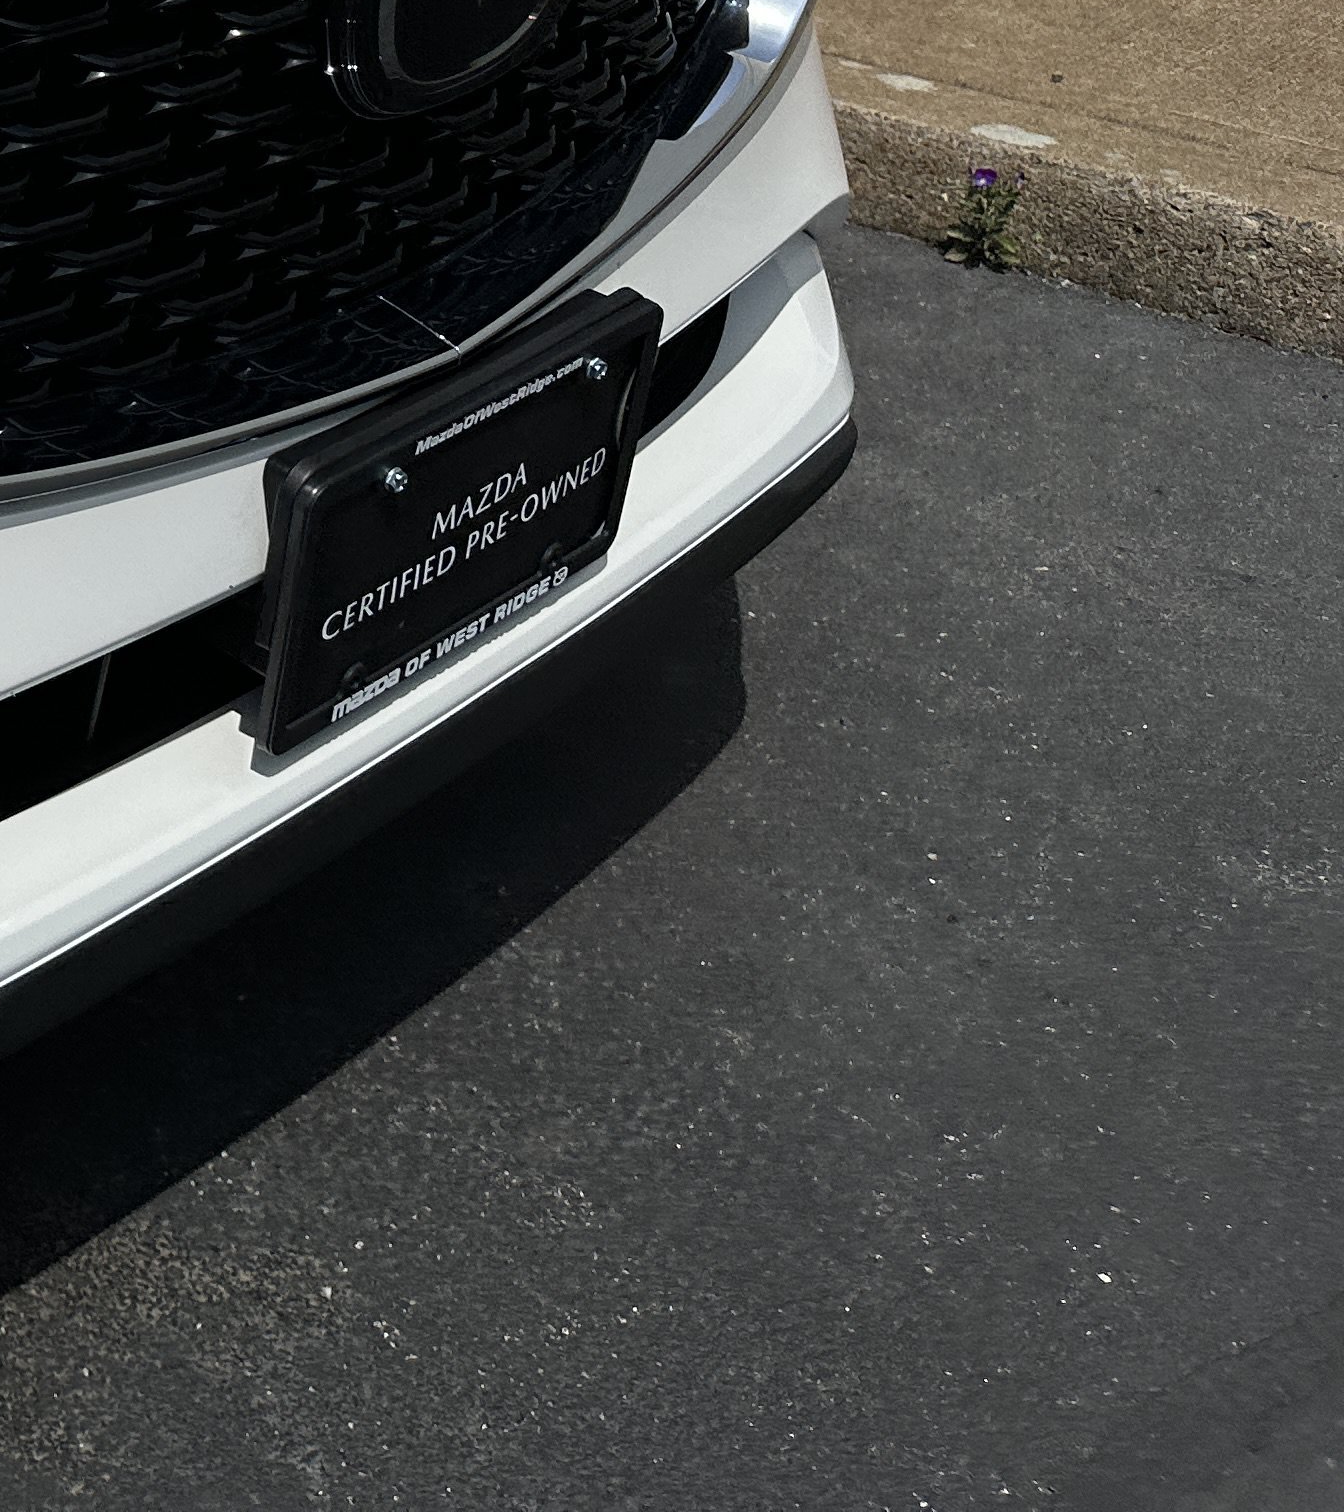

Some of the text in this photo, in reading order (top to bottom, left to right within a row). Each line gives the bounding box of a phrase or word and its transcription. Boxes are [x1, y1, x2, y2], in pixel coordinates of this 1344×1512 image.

[321, 447, 606, 640] CERTIFIED PRE-OWNED
[431, 462, 528, 540] MAZDA
[404, 649, 432, 678] OF
[435, 613, 491, 659] WEST
[493, 576, 552, 624] RIDGE
